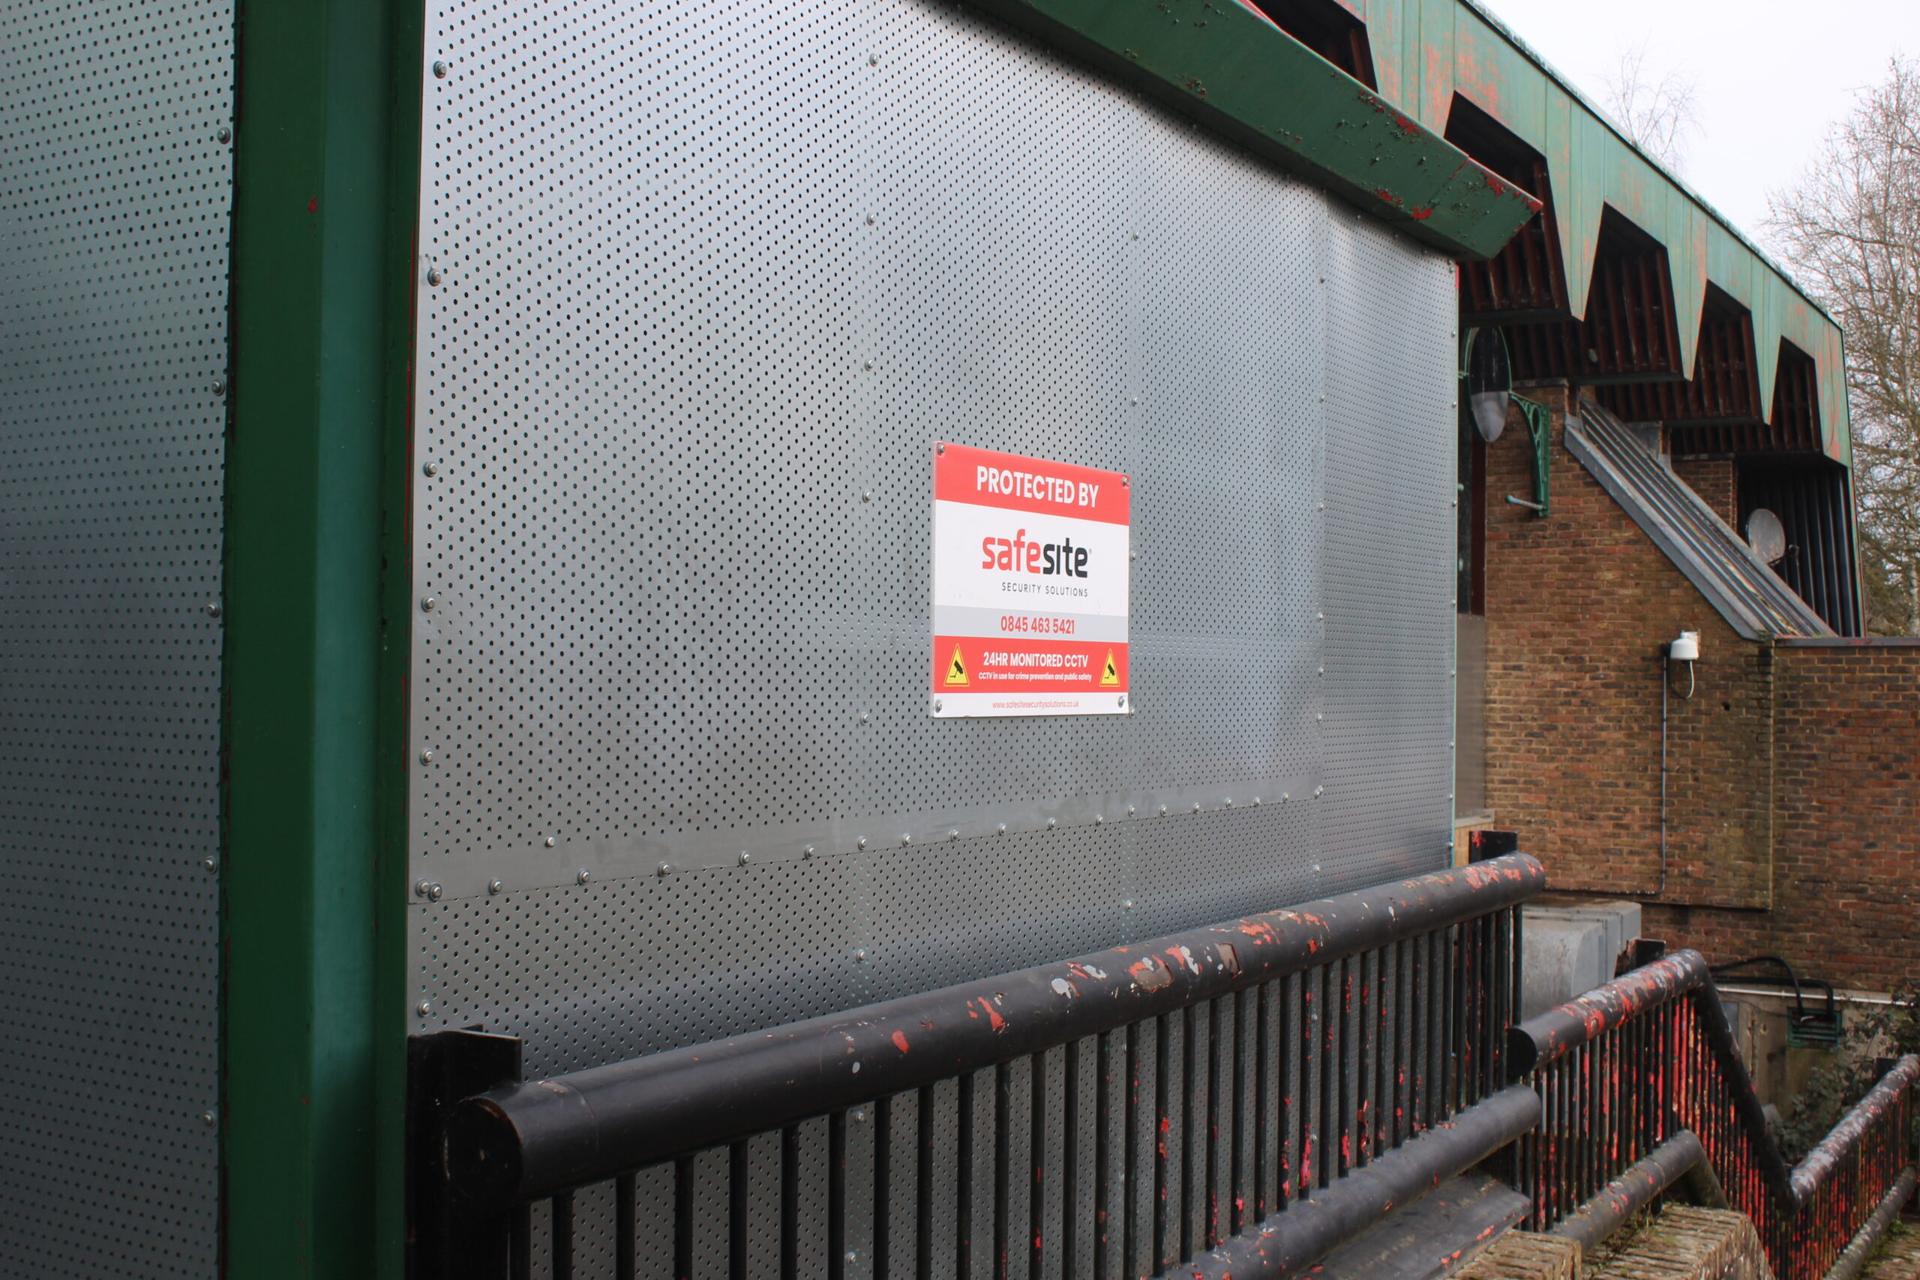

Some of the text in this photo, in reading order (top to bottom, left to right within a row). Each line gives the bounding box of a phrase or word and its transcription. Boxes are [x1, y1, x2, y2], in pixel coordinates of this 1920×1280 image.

[976, 465, 1099, 508] PROTECTED BY
[981, 528, 1088, 578] safesite
[1001, 581, 1088, 597] SECURITY SOLUTIONS
[1000, 615, 1075, 634] 0845 463 5421
[983, 651, 1088, 668] 24HR MONITORED CCTV
[978, 671, 993, 680] CCTV
[993, 672, 998, 680] in
[1015, 672, 1029, 680] crime
[1029, 672, 1054, 682] prevention
[1054, 672, 1063, 680] and
[1063, 673, 1078, 682] public
[1078, 673, 1092, 683] safety
